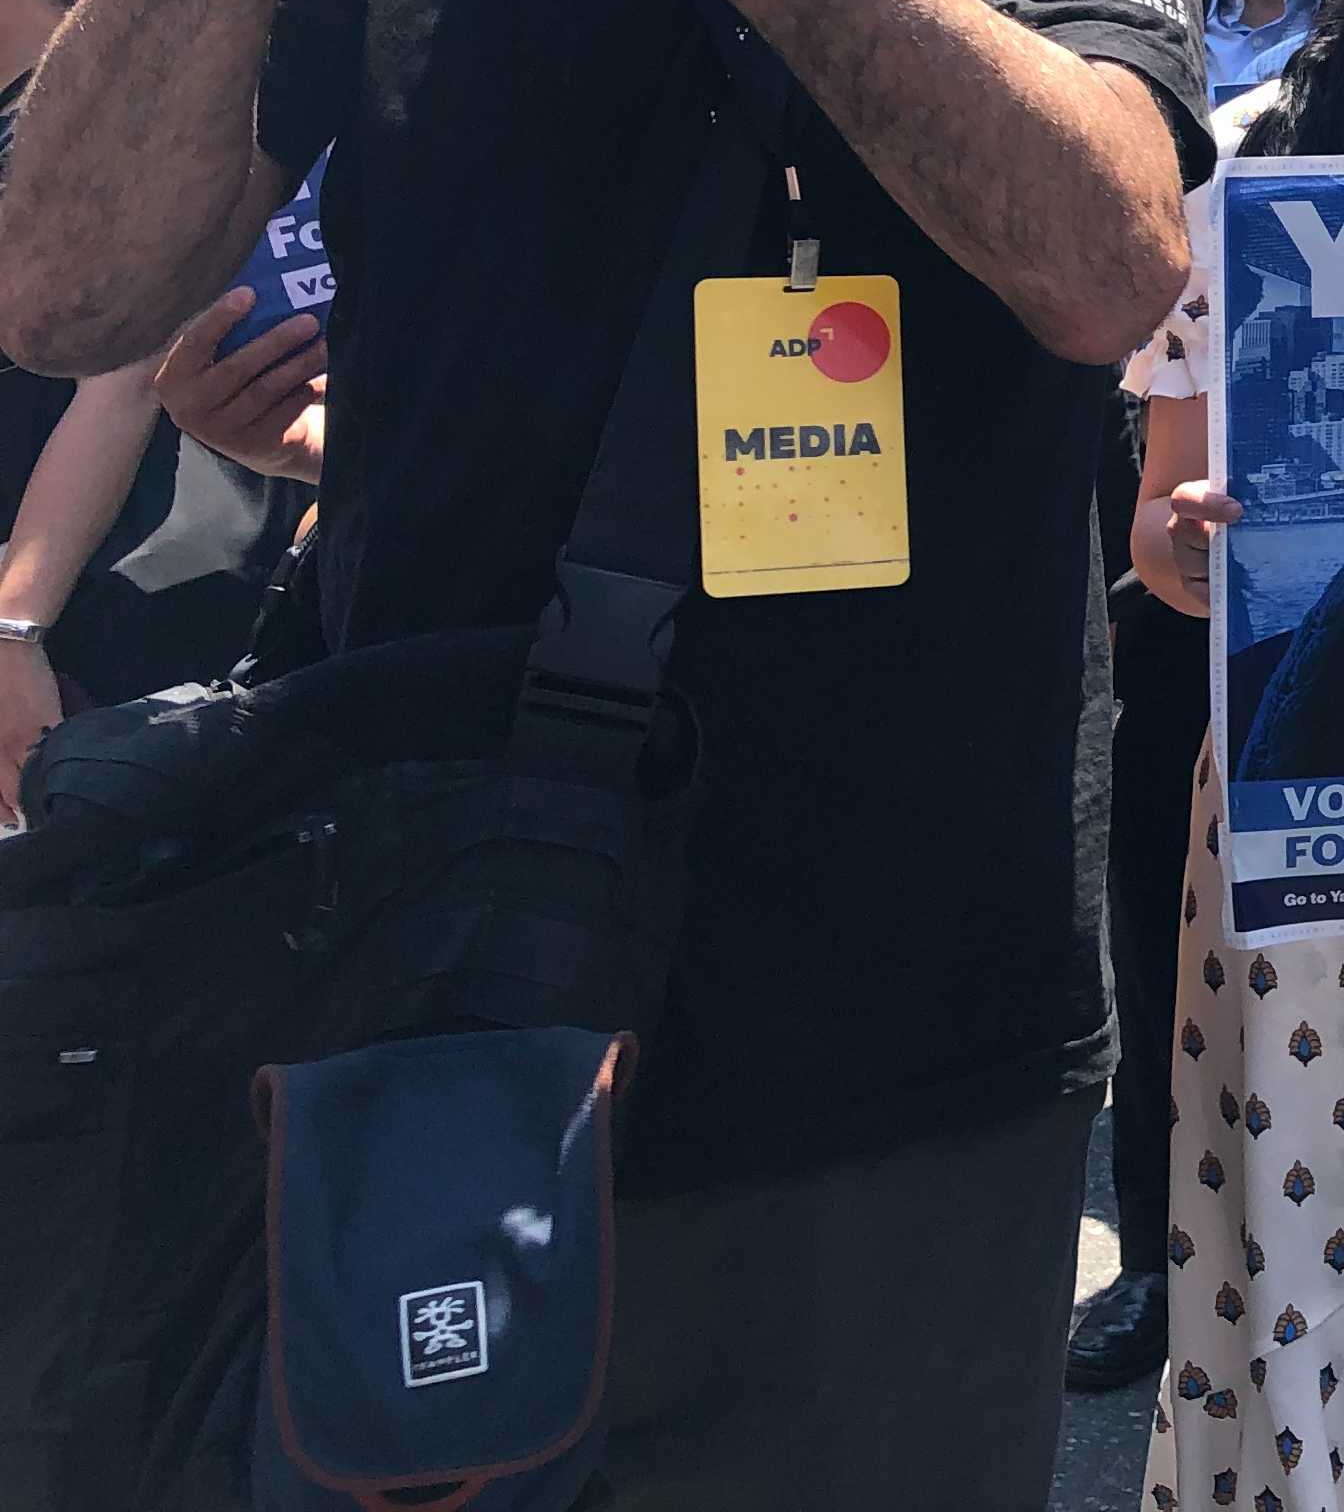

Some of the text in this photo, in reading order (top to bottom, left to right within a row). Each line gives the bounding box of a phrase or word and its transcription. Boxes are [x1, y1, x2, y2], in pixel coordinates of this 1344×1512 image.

[769, 338, 822, 358] ADP
[725, 422, 881, 462] MEDIA
[1283, 893, 1306, 908] Go
[1309, 891, 1327, 906] to
